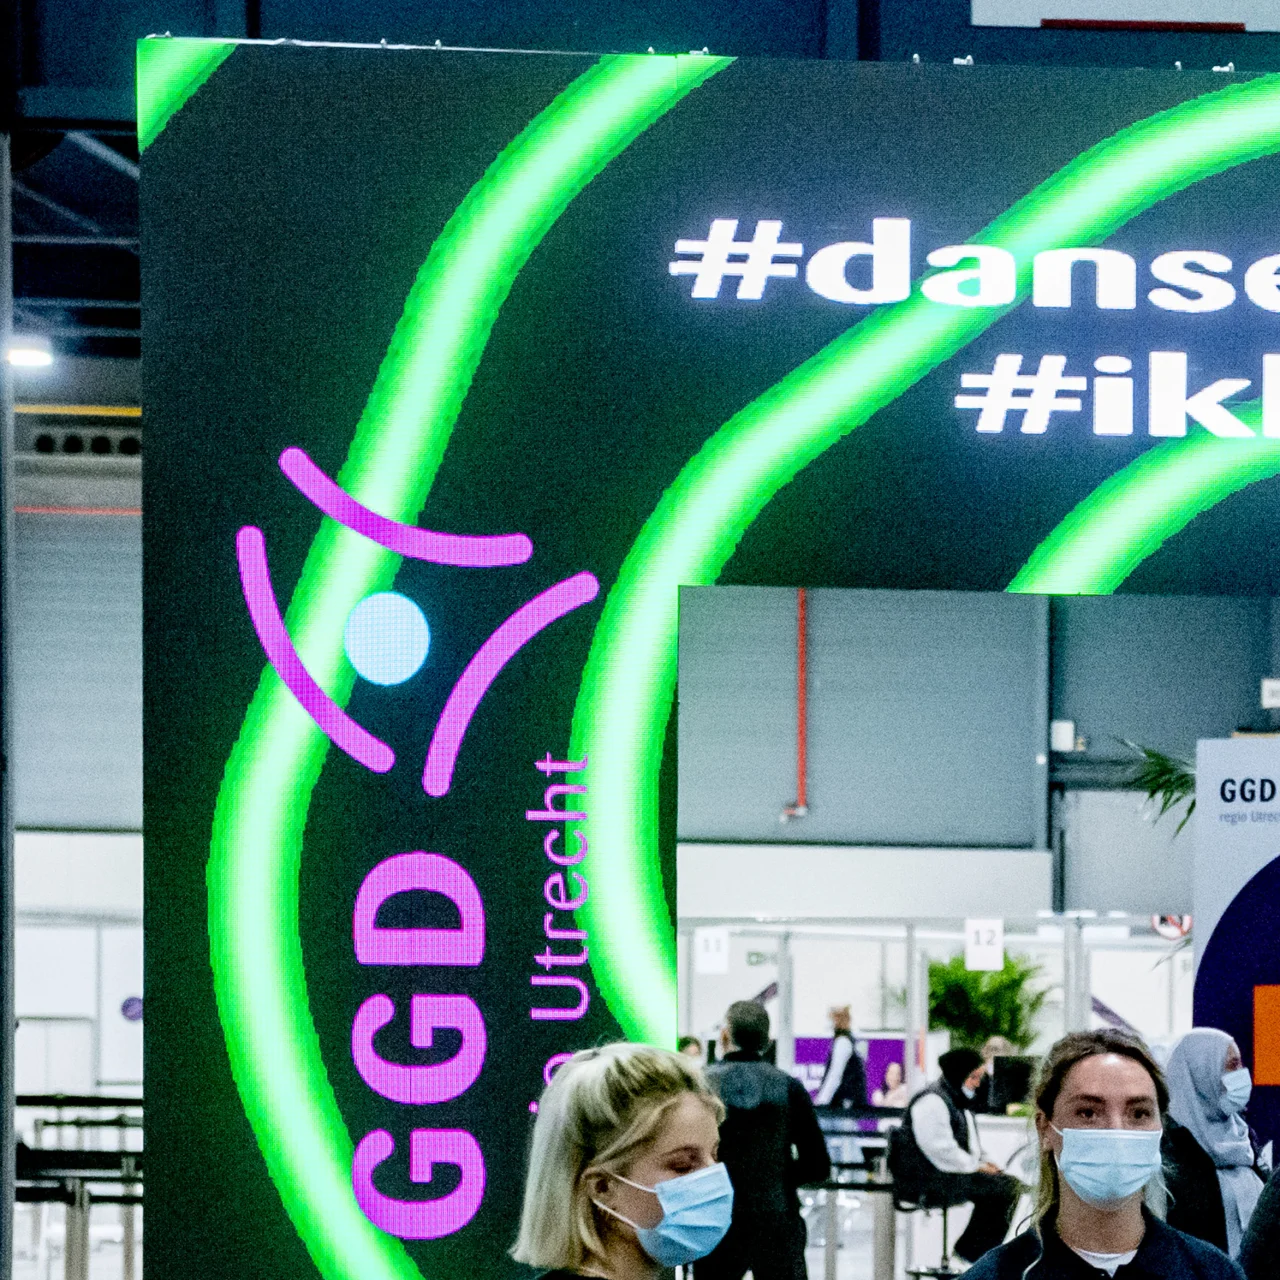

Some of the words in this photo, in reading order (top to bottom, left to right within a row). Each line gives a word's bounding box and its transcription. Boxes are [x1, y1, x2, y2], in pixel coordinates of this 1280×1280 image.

[1220, 778, 1277, 803] GGD
[526, 751, 590, 1022] Utrecht
[973, 929, 997, 946] 12
[352, 850, 488, 1241] GGD
